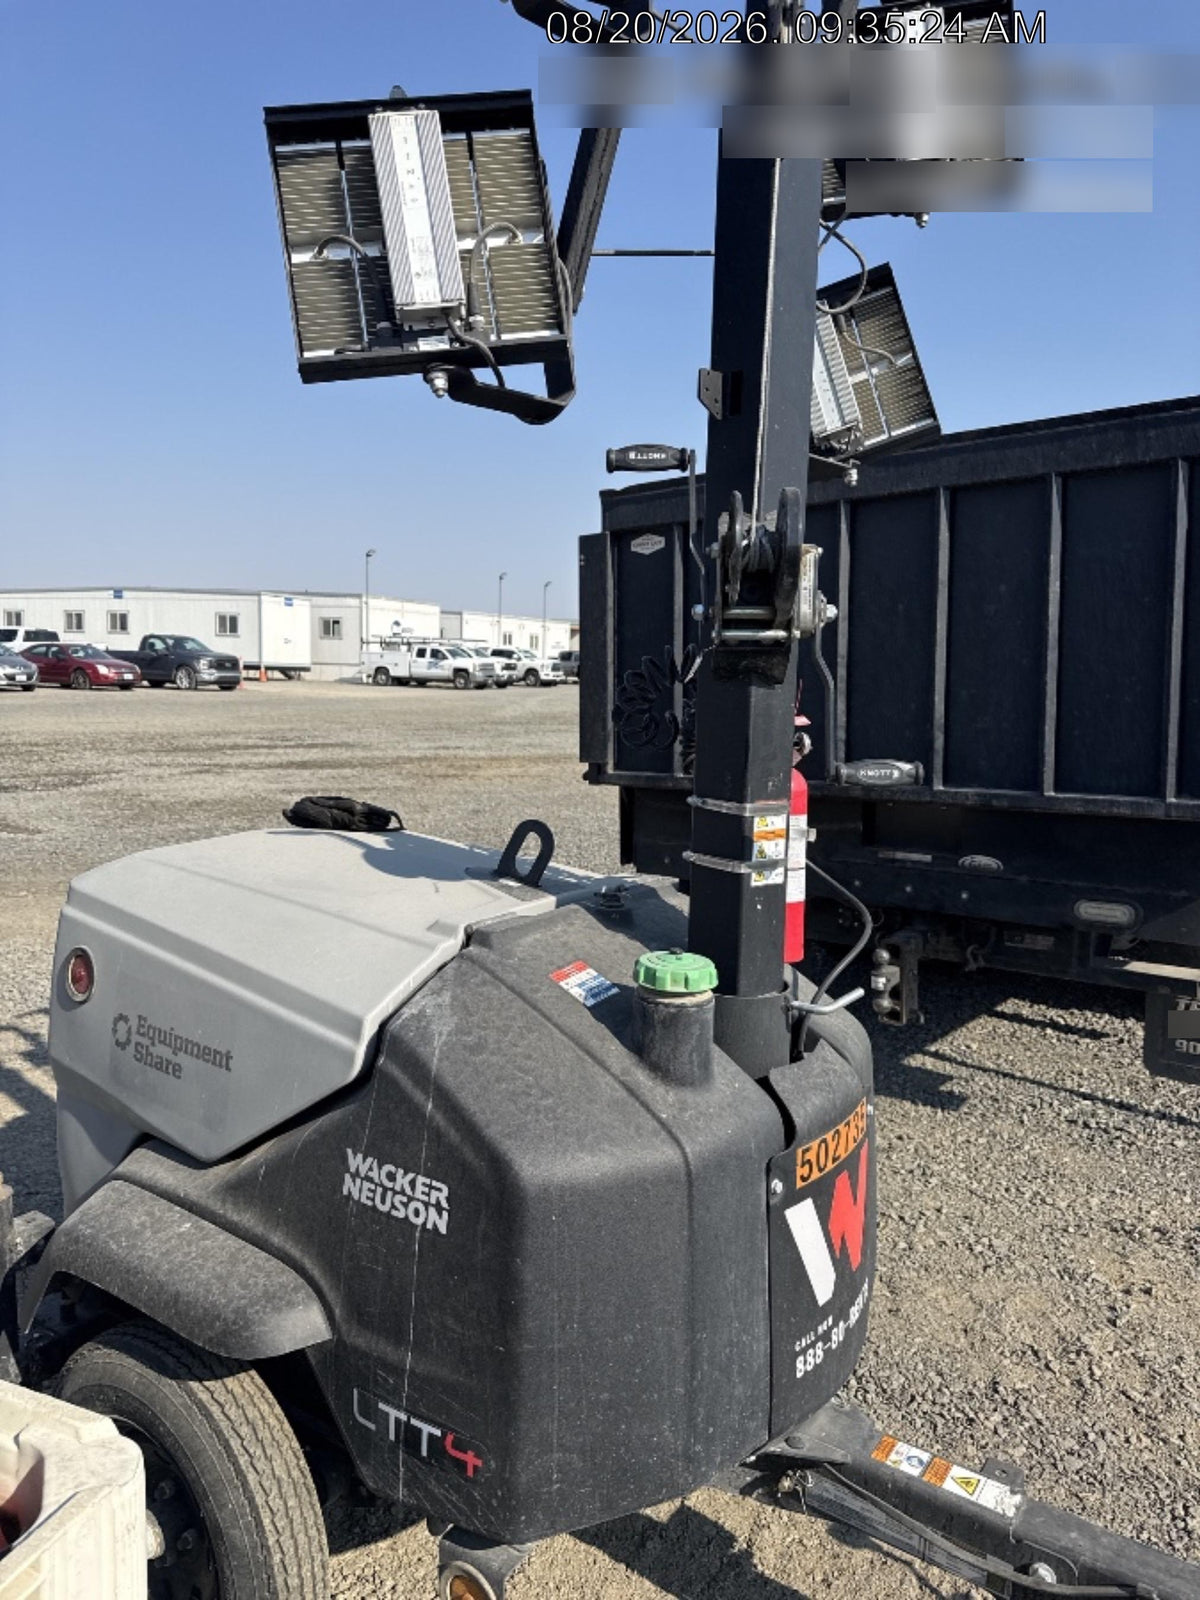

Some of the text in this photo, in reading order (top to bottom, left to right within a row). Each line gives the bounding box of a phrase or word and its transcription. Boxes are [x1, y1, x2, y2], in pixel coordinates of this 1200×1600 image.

[859, 769, 892, 777] KNOTT
[133, 1041, 182, 1080] Share
[136, 1014, 233, 1073] Equipment
[342, 1172, 449, 1235] NEUSON
[346, 1147, 450, 1210] WACKER
[353, 1388, 483, 1478] LTT4
